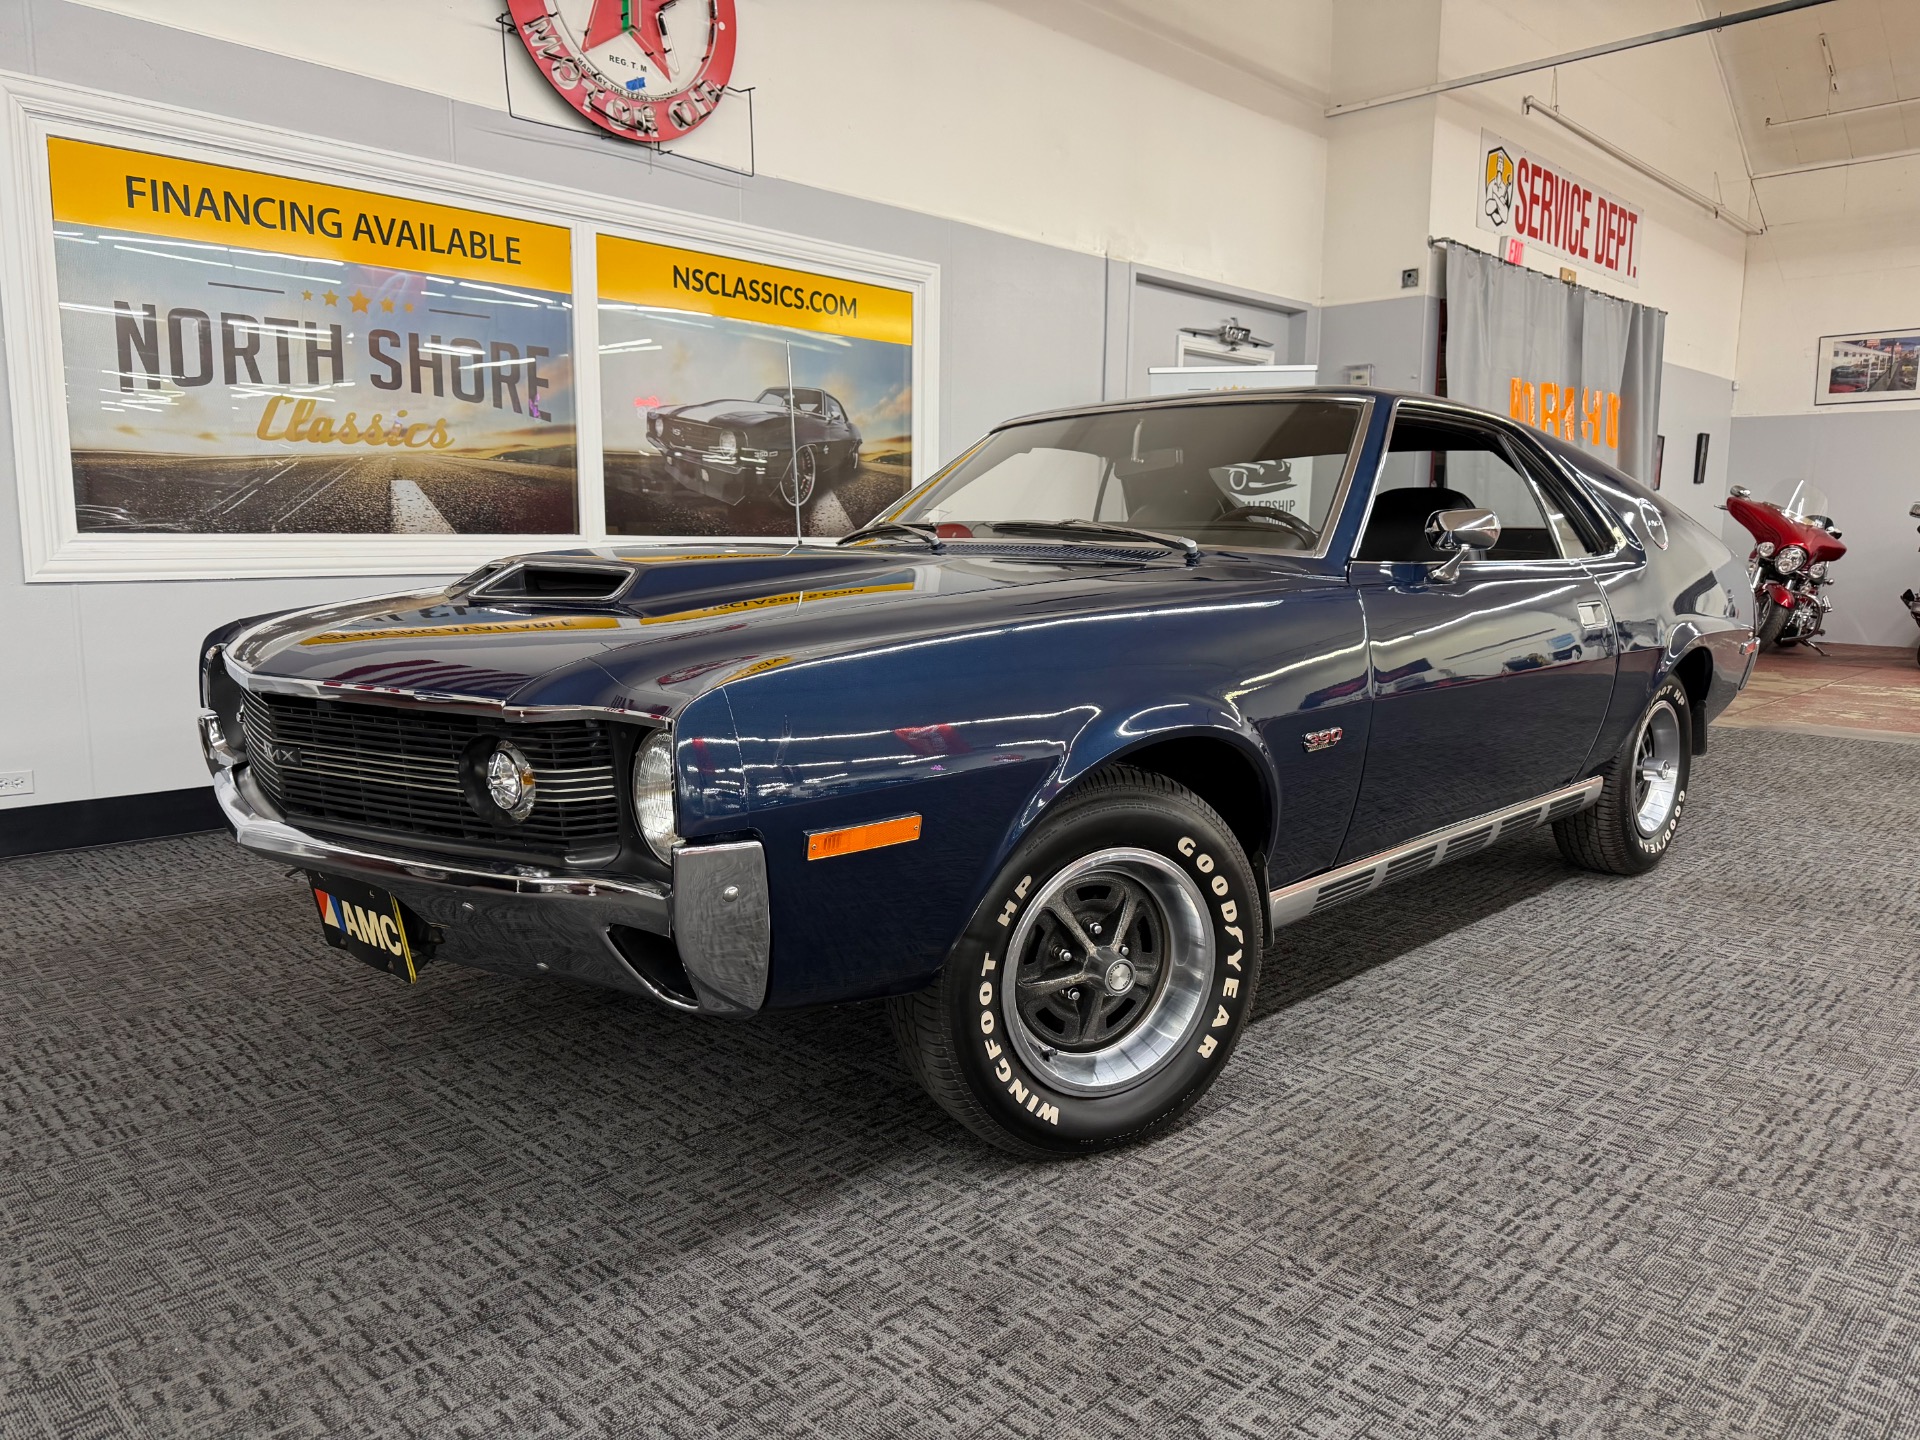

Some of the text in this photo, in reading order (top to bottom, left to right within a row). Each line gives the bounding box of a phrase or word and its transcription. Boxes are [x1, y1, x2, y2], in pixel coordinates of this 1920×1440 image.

[523, 15, 659, 138] MOTOR
[609, 54, 629, 67] REG.
[610, 84, 624, 95] THE
[124, 175, 522, 265] FINANCING AVAILABLE
[1514, 157, 1638, 278] SERVICE DEPT.
[673, 265, 858, 319] NSCLASSICS.COM
[114, 300, 552, 422] NORTH SHORE
[256, 394, 456, 449] Classics
[1673, 689, 1685, 706] HP
[1304, 727, 1343, 747] 390
[341, 899, 402, 956] AMC
[1177, 836, 1244, 1060] GOODYEAR
[979, 875, 1060, 1126] WINGFOOT HP
